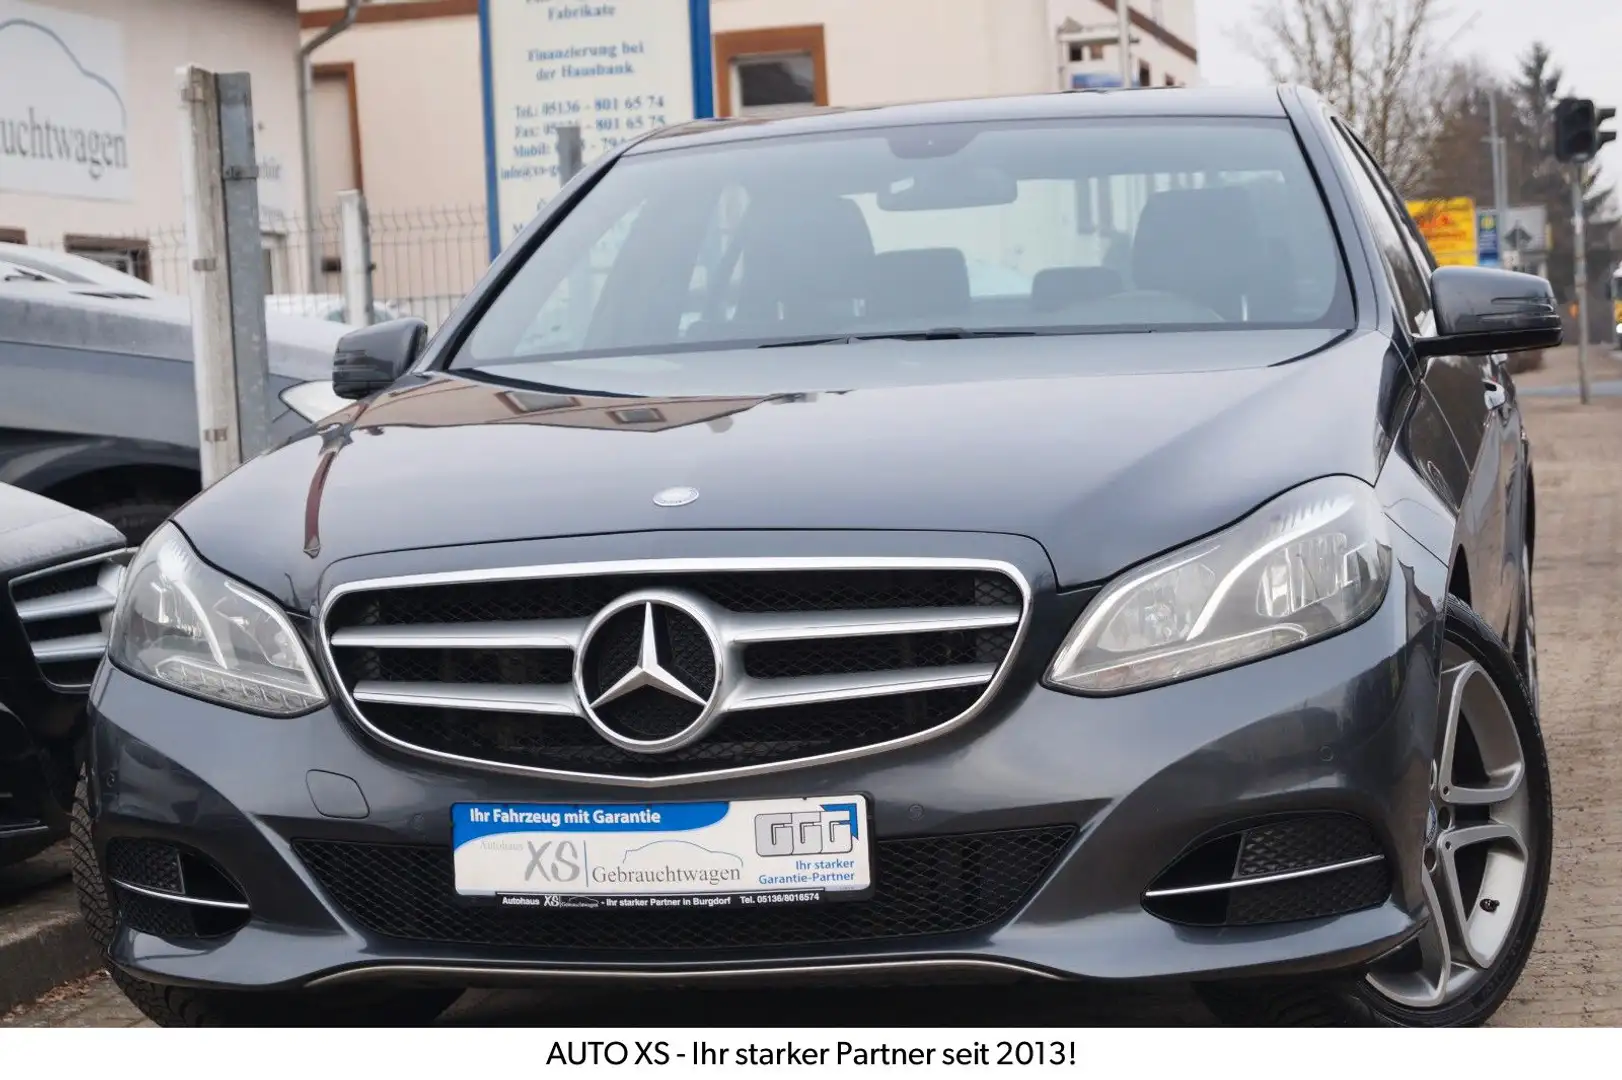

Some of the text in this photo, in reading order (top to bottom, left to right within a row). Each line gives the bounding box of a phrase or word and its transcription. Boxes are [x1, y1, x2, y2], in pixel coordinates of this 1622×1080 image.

[548, 4, 616, 21] Fabrikate
[527, 40, 644, 62] Finanzierung bei
[536, 61, 634, 81] der Hausbank
[541, 101, 581, 116] 05136
[594, 98, 619, 111] 801
[625, 96, 642, 109] 65
[649, 96, 665, 108] 74
[514, 126, 538, 139] Fax:
[595, 117, 620, 130] 801
[626, 116, 643, 129] 65
[649, 115, 666, 127] 75
[513, 143, 551, 158] Mobil:
[470, 807, 662, 827] Ihr Fahrzeug mit Garantie
[524, 840, 581, 883] XS
[591, 864, 741, 885] Gebrauchtwagen
[795, 858, 855, 870] Ihr starker
[758, 872, 855, 885] Garantie-Partner
[502, 896, 541, 906] Autohaus
[543, 895, 560, 907] XS
[606, 898, 618, 906] Ihr
[619, 898, 648, 906] starker
[650, 898, 681, 906] Partner
[683, 898, 692, 906] in
[693, 896, 731, 907] Burgdorf
[740, 896, 756, 905] Tel.
